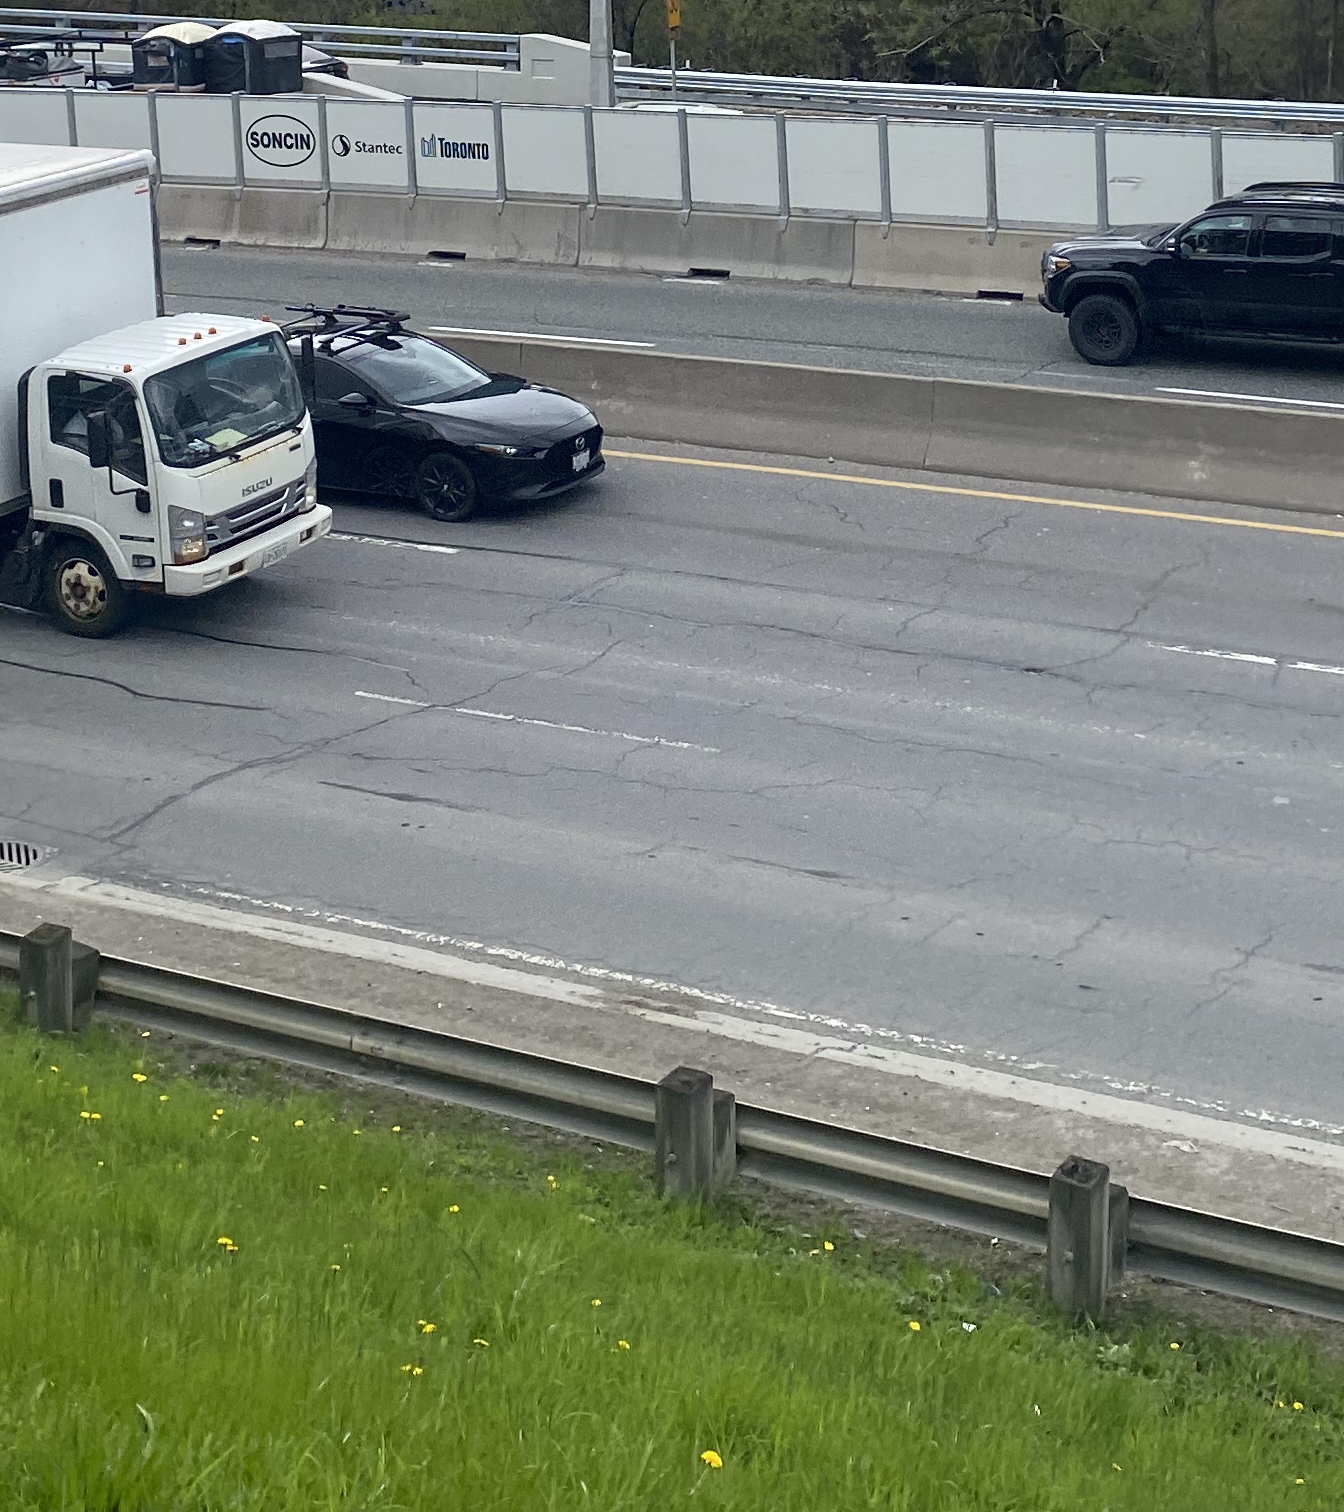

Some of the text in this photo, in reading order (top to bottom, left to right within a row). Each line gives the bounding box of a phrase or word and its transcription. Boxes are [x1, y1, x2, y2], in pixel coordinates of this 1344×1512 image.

[249, 131, 311, 150] SONCIN
[354, 140, 404, 155] Stantec
[437, 137, 490, 161] TORONTO
[241, 476, 273, 497] ISUZU
